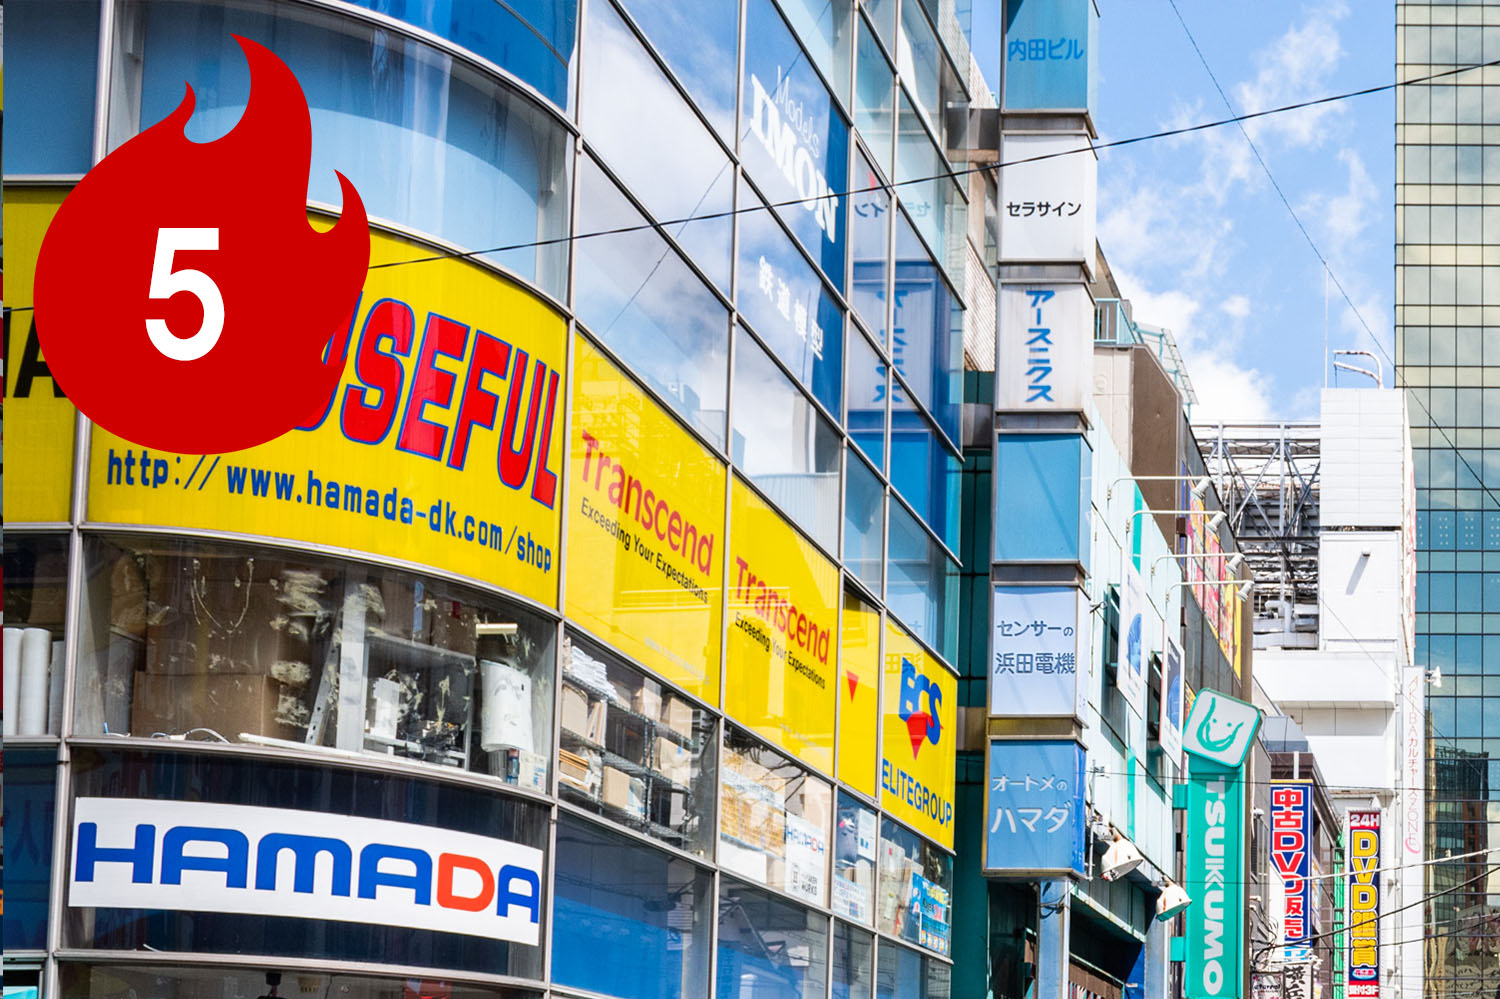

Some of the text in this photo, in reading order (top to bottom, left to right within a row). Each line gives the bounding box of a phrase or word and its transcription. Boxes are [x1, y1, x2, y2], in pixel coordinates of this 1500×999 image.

[1007, 38, 1084, 62] 内田ビル
[1006, 201, 1082, 219] セラサイン
[1025, 289, 1056, 403] アースニクス
[581, 430, 716, 577] Transcend
[580, 497, 709, 605] Exceeding Your Expectations
[735, 556, 830, 665] Transcend
[996, 619, 1074, 639] センサーの
[735, 611, 770, 653] Exceeding
[787, 649, 826, 690] Expectations
[994, 651, 1077, 676] 浜田電機
[881, 758, 953, 829] ELITEGROUP
[991, 776, 1068, 792] オートメの
[991, 801, 1073, 834] ハマダ
[1350, 813, 1380, 827] 24H
[75, 822, 540, 924] HAMADA
[1202, 775, 1226, 996] TSUKUMO
